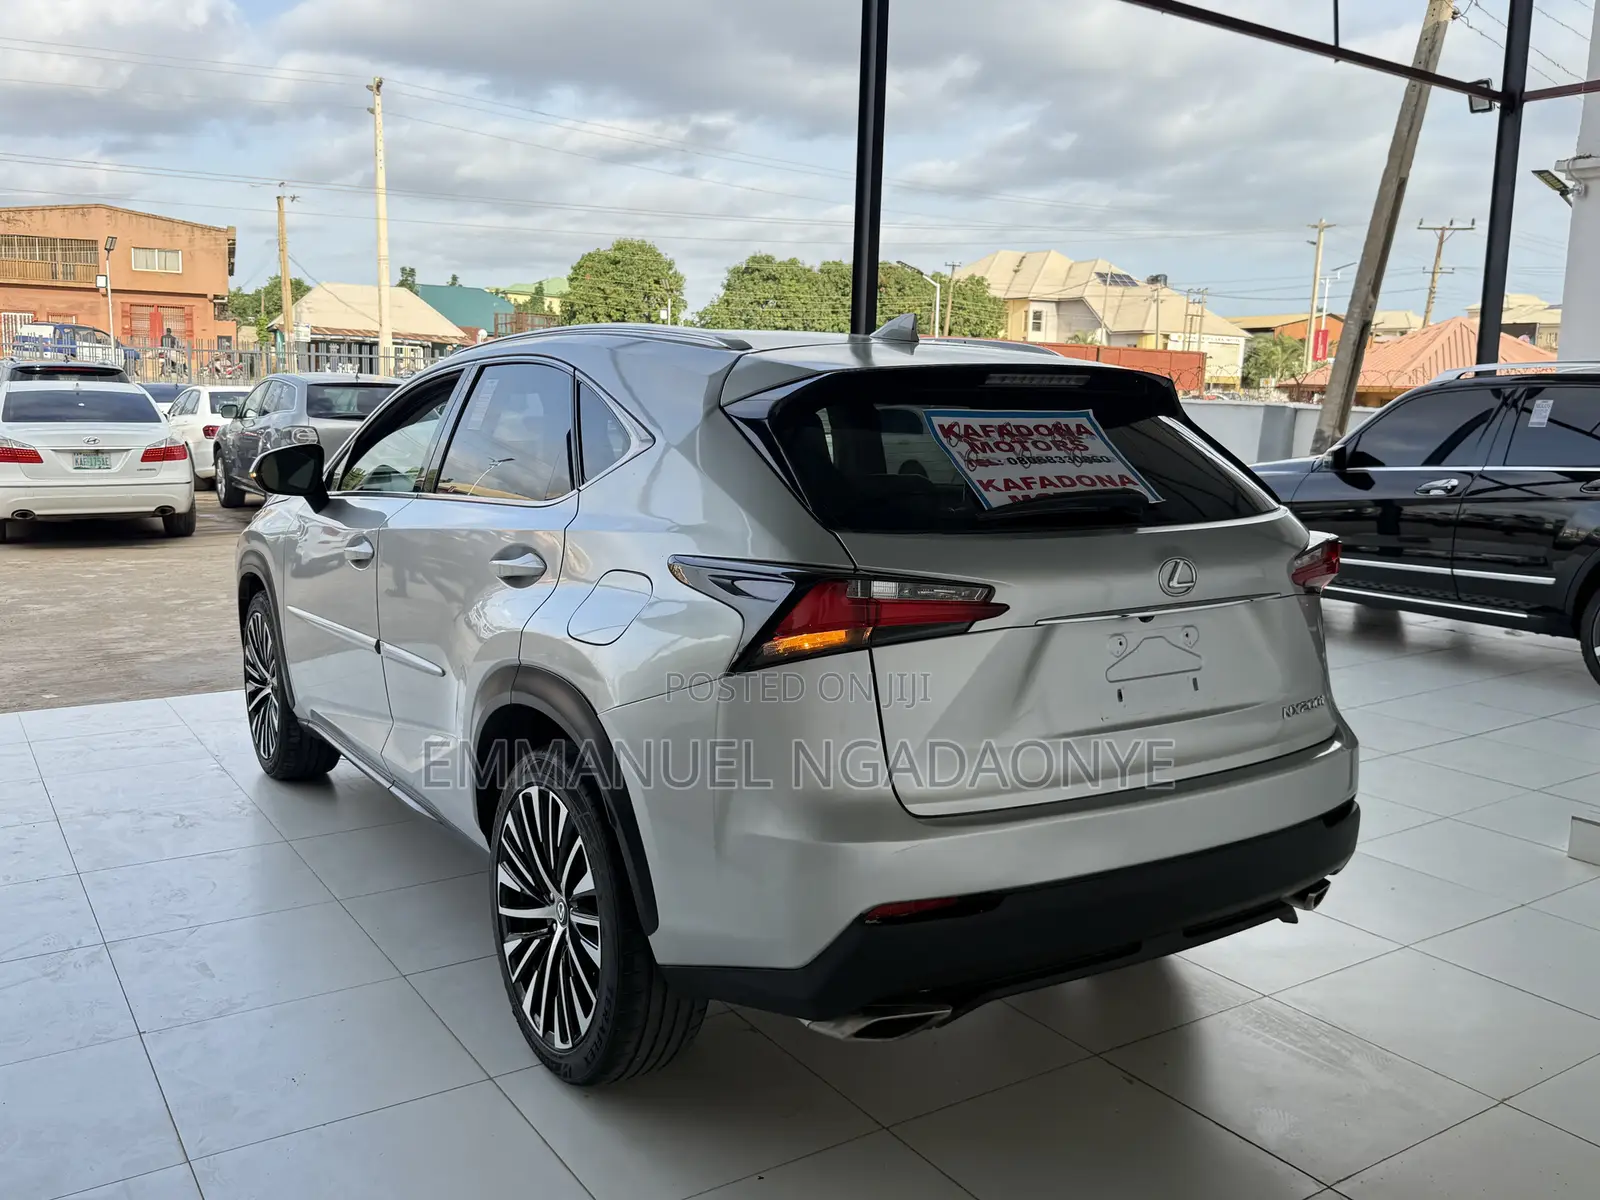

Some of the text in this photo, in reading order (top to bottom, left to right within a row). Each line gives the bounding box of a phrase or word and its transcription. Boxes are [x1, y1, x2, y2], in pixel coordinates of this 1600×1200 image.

[938, 424, 1097, 440] KAFADONA
[966, 438, 1090, 454] MOTORS
[976, 474, 1139, 492] KAFADONA
